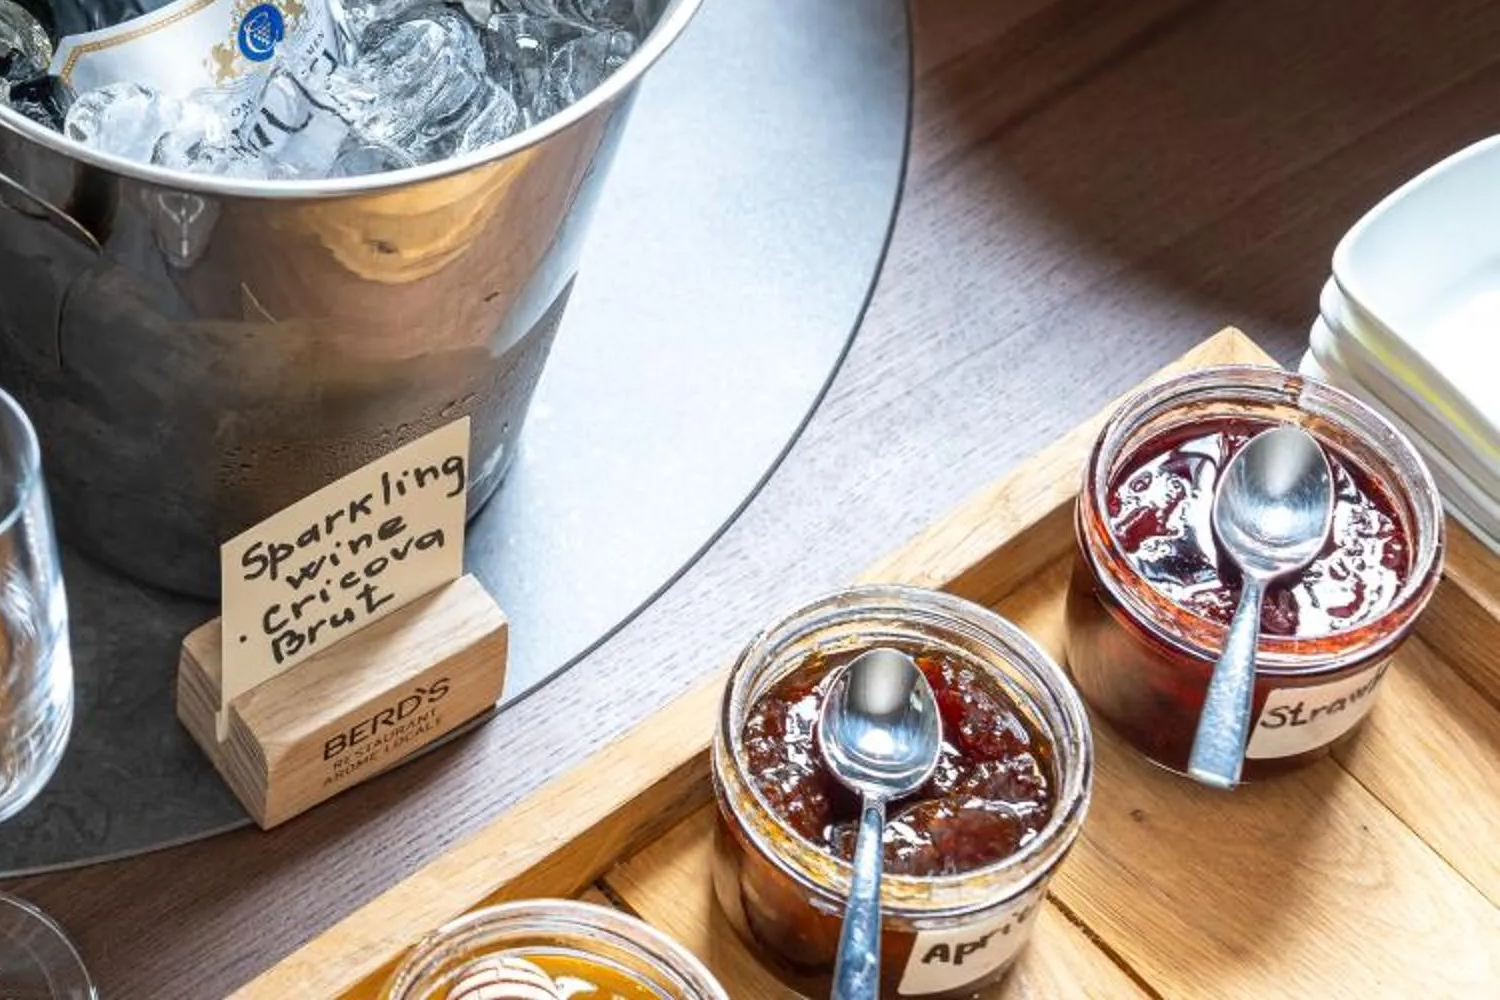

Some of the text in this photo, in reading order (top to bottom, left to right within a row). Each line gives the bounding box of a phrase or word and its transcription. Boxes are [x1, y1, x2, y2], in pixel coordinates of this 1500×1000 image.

[241, 455, 465, 581] Sparkling
[285, 515, 408, 590] wine
[263, 528, 445, 634] Cricova
[271, 583, 395, 665] Brut
[334, 707, 437, 771] RESTAURANT
